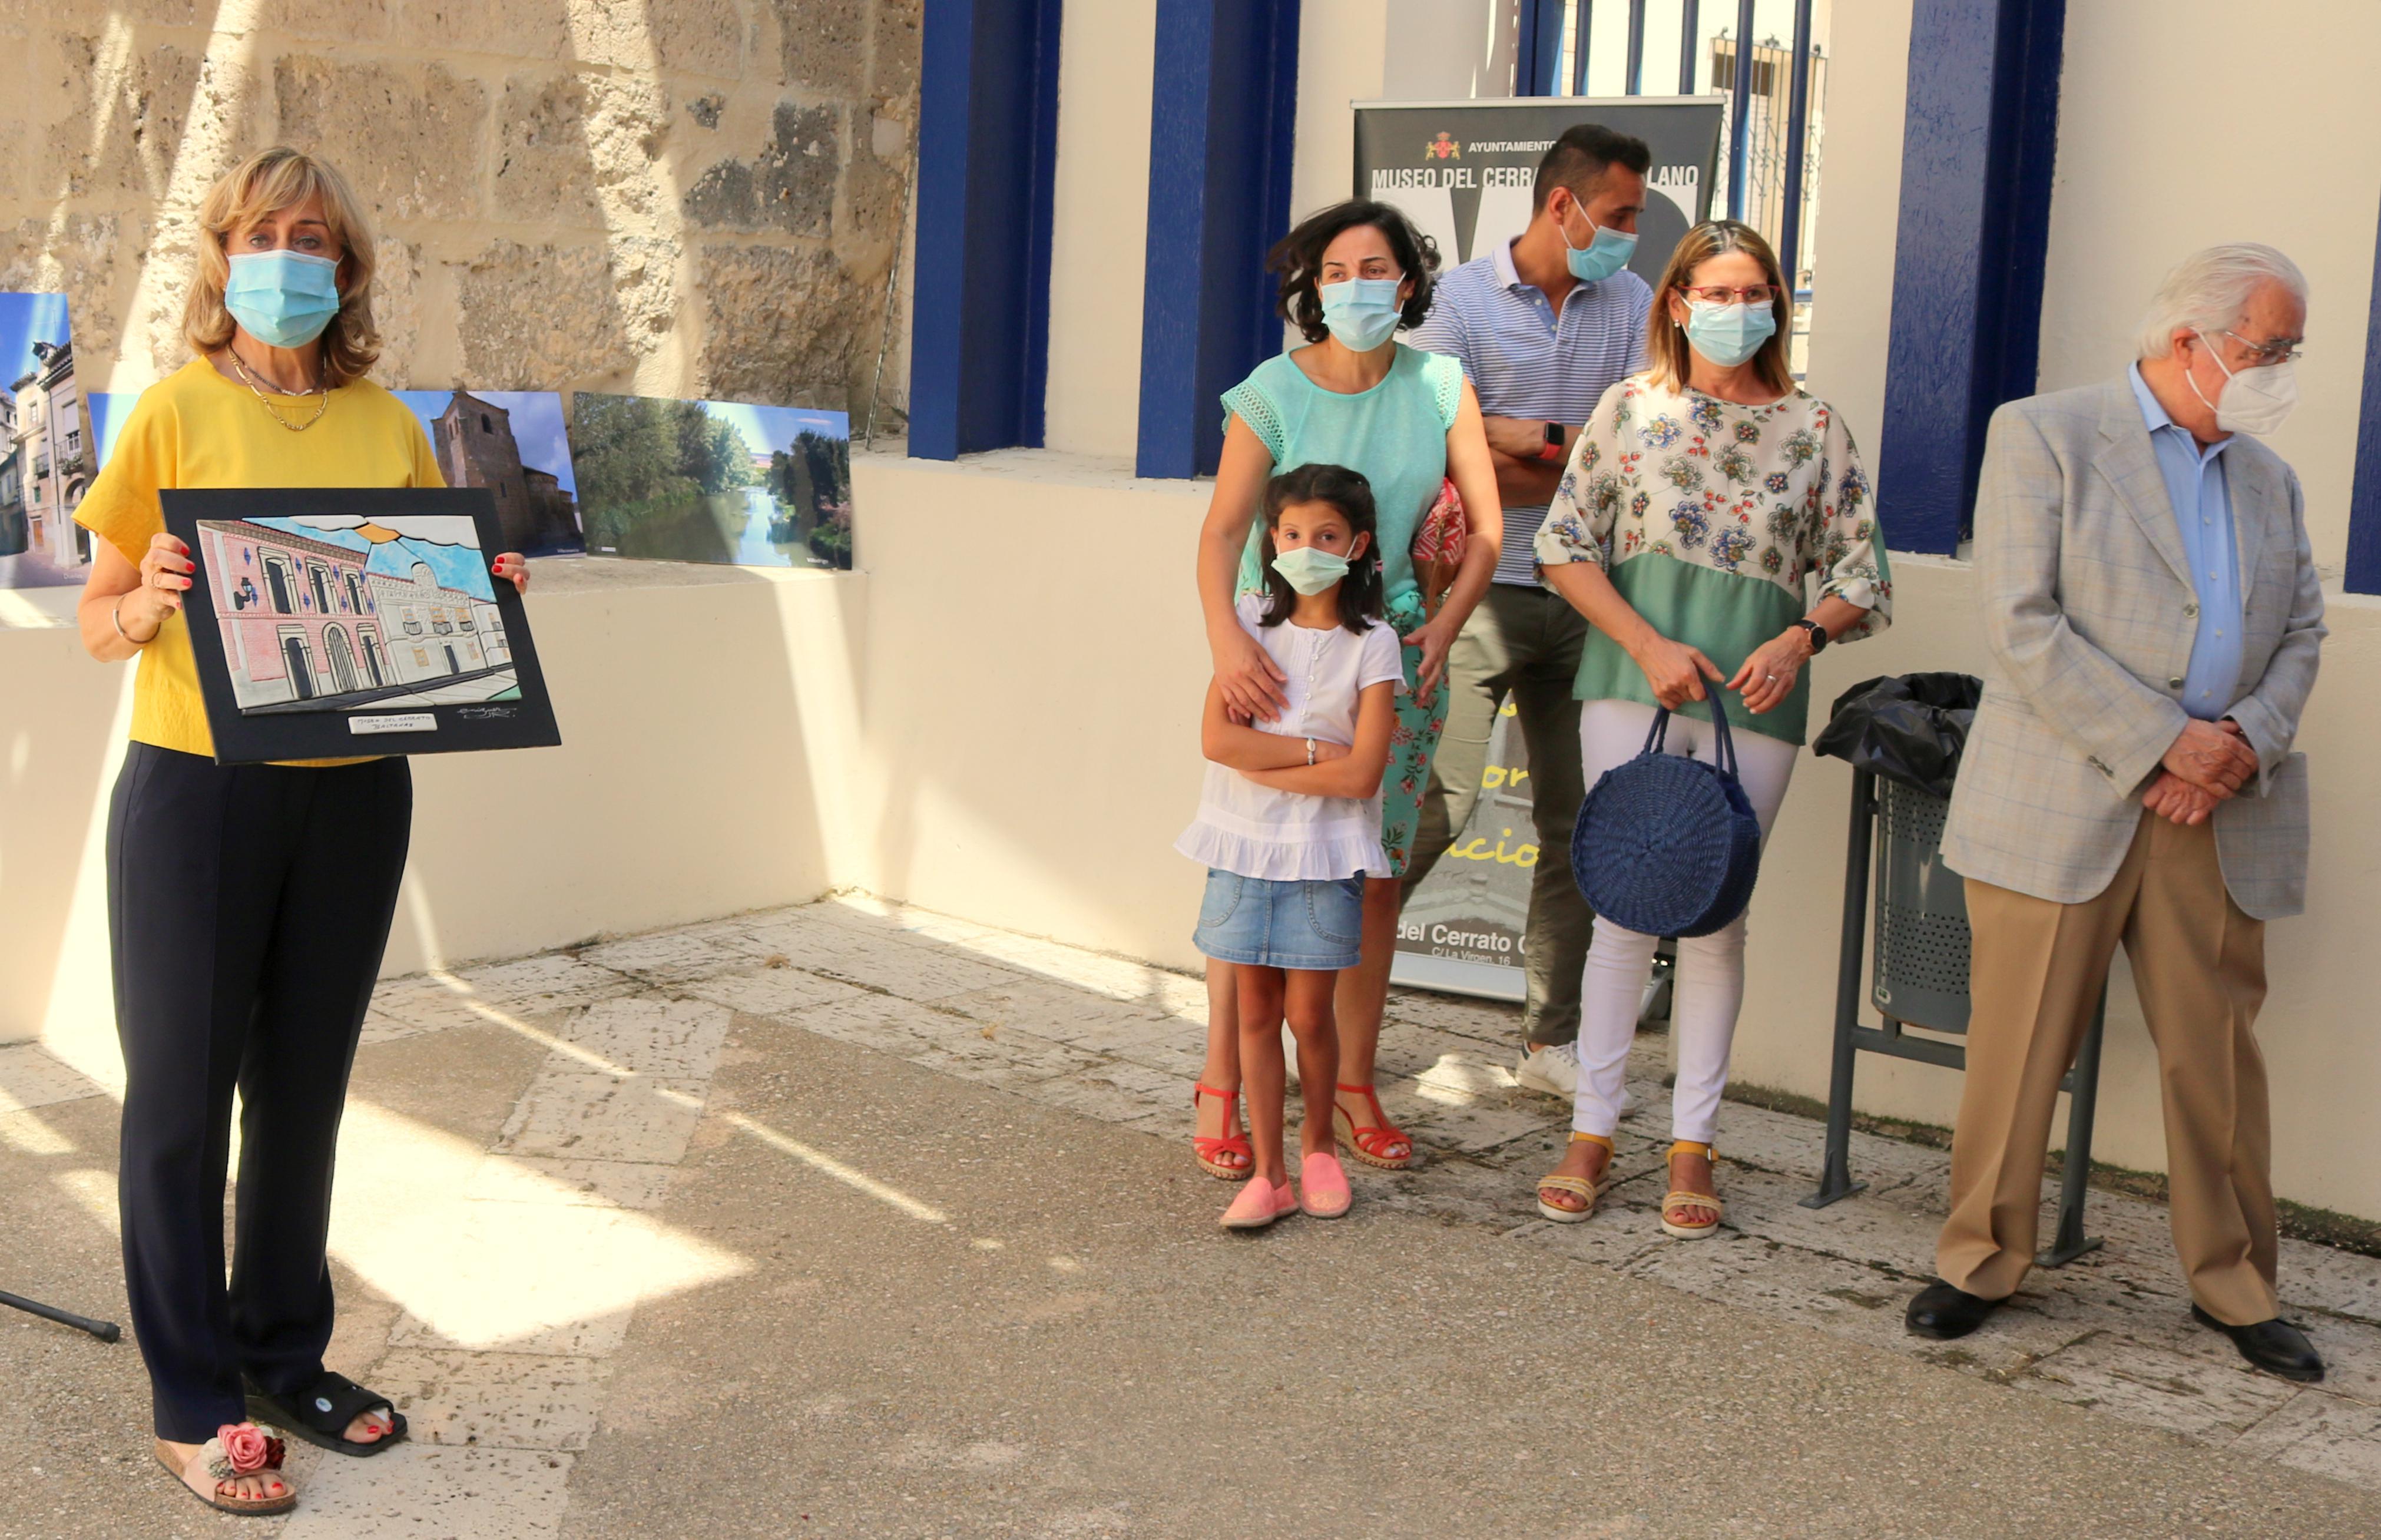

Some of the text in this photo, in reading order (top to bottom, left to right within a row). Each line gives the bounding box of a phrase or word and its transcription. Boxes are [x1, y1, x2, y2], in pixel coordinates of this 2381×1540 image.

[1372, 165, 1699, 188] MUSEO DEL CERR LANO
[1396, 920, 1426, 941] del
[1431, 924, 1512, 952] Cerrato
[1431, 946, 1443, 957] C/
[1446, 949, 1458, 959] La
[1498, 956, 1511, 966] 16
